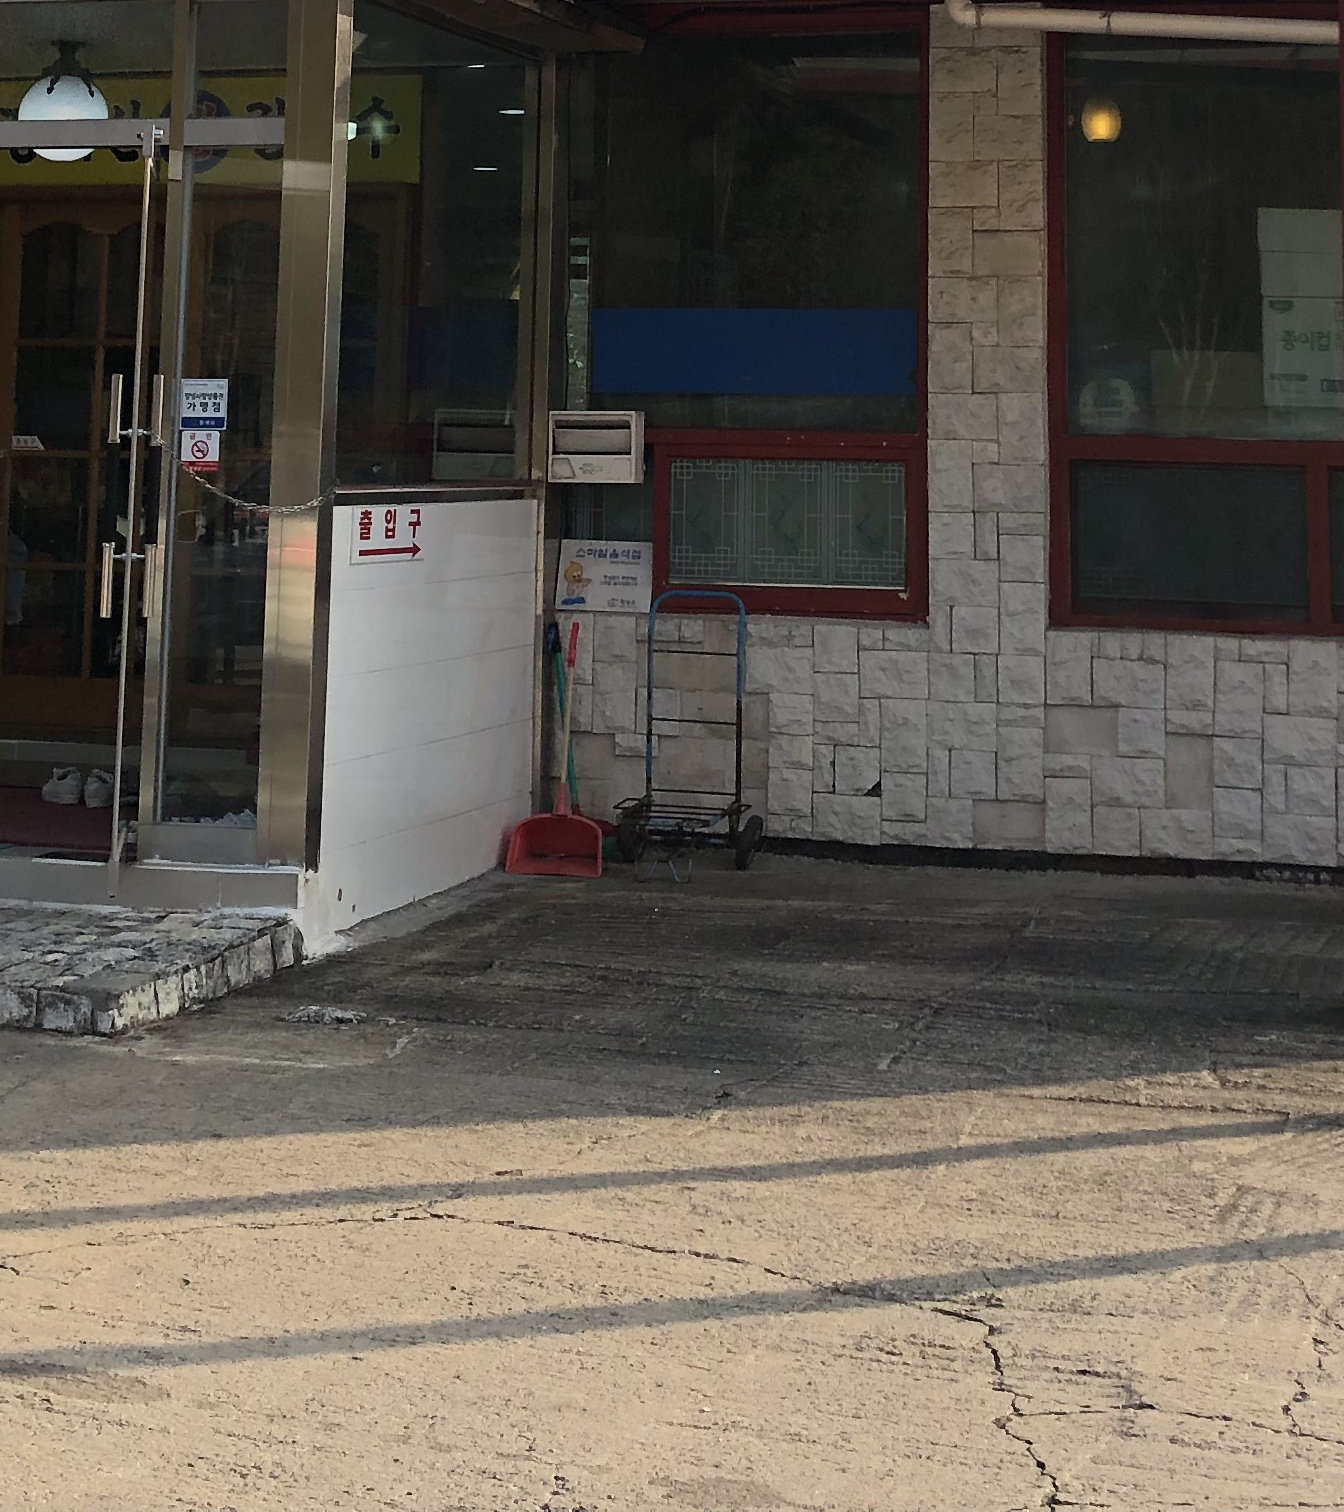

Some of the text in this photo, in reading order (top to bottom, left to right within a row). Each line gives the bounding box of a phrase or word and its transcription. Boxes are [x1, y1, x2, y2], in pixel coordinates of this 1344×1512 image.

[1281, 330, 1330, 351] 종이컵
[187, 401, 221, 413] 가맹점
[359, 509, 422, 540] 출입구
